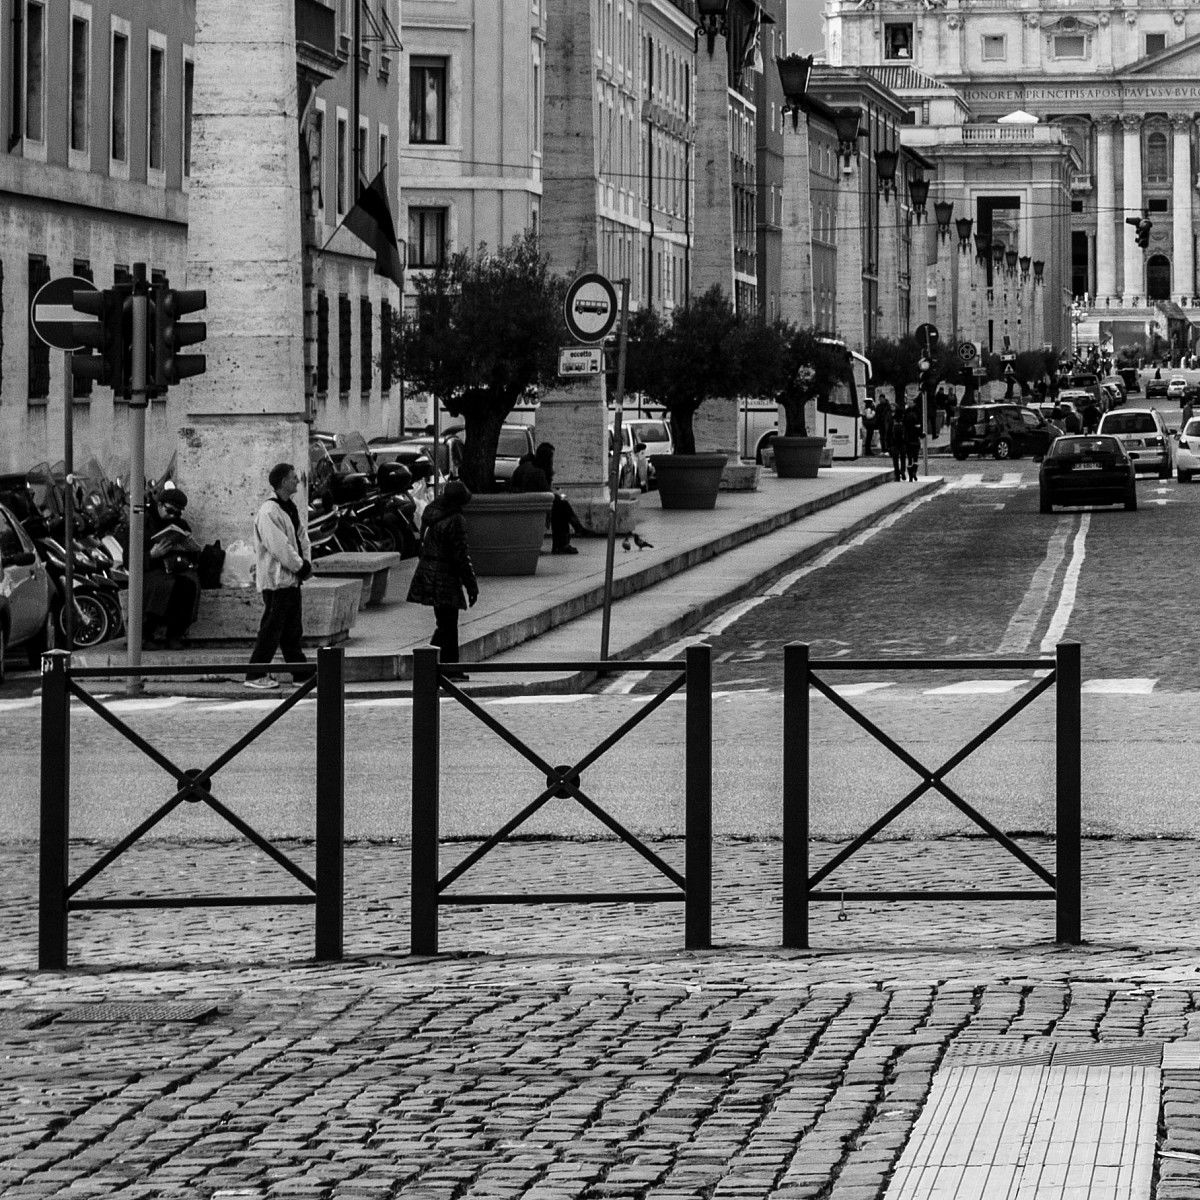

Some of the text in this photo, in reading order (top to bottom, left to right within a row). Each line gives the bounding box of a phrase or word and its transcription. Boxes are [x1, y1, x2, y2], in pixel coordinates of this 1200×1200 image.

[963, 90, 1023, 100] HONOREM
[1026, 89, 1086, 99] PRINCIPIS
[1124, 87, 1163, 98] PAVLVS
